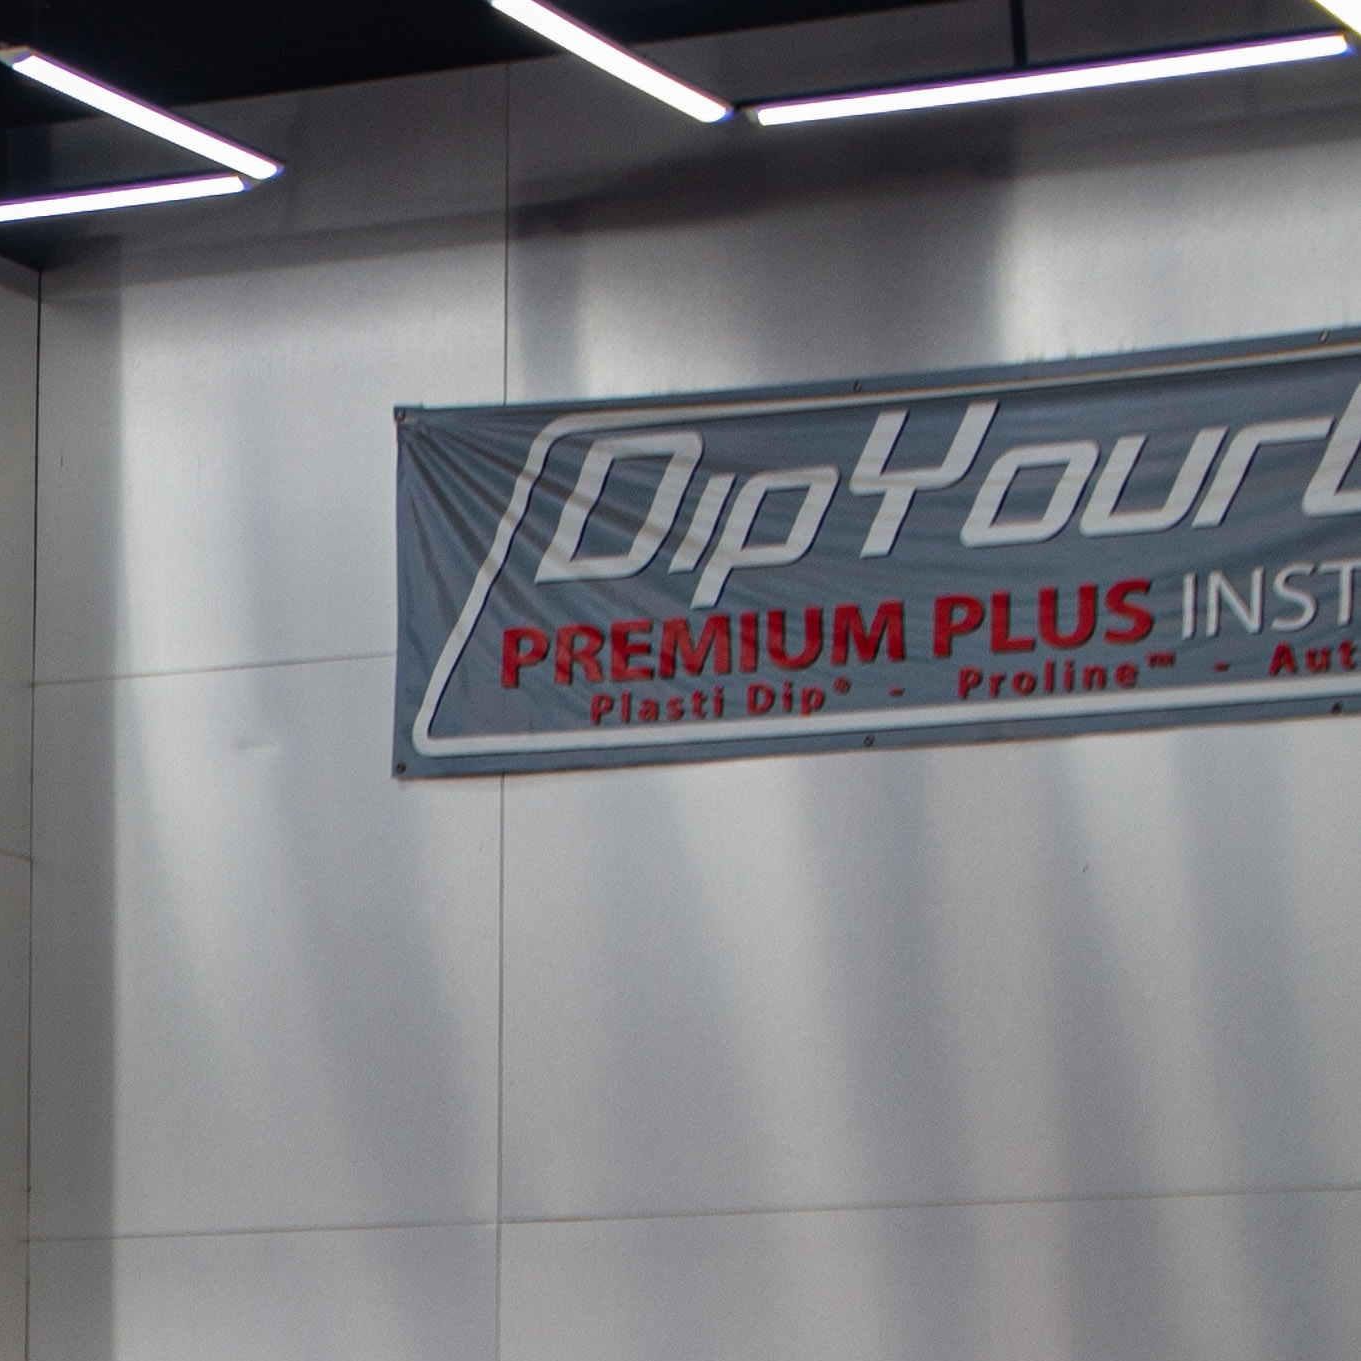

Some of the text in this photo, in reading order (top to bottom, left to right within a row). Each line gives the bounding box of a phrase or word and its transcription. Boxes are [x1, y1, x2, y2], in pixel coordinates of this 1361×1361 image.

[500, 601, 906, 688] PREMIUM
[932, 578, 1154, 660] PLUS
[590, 684, 724, 726] Plasti
